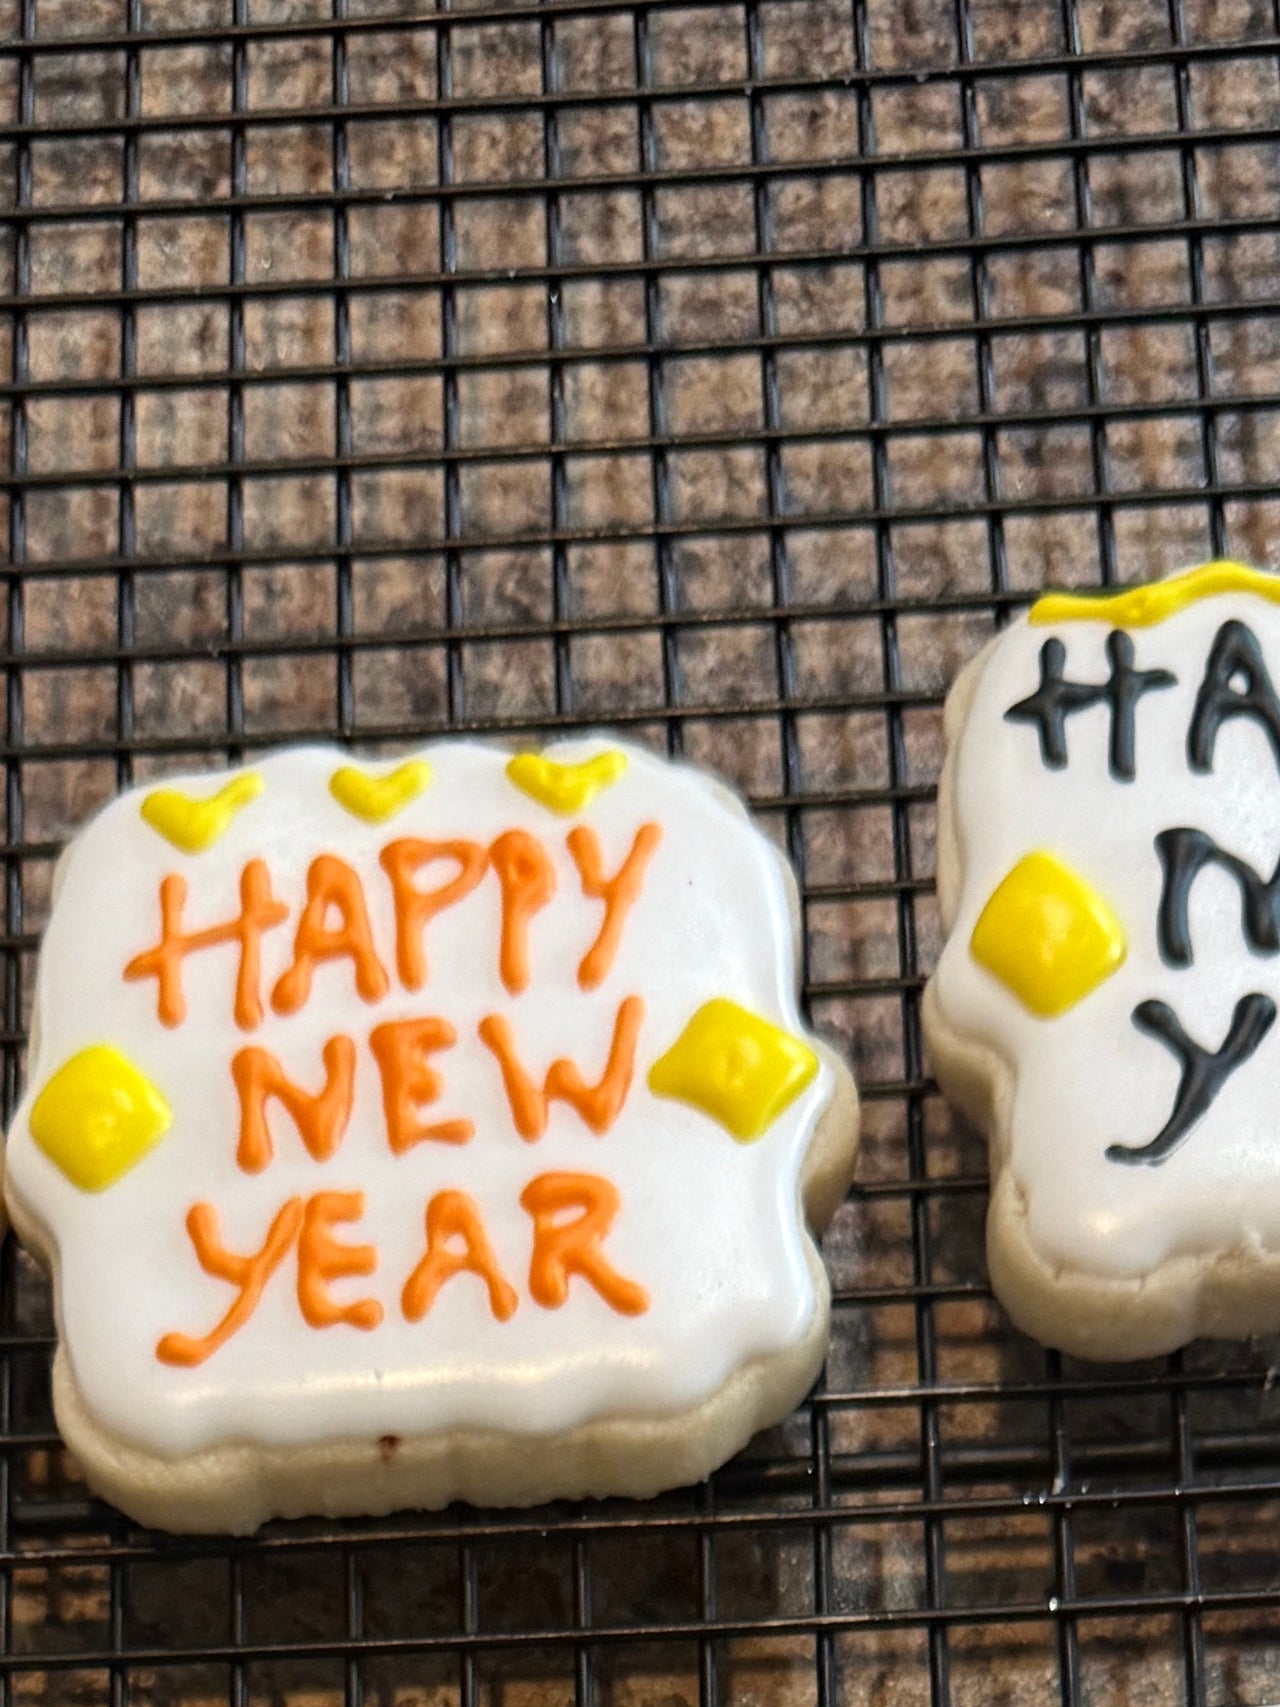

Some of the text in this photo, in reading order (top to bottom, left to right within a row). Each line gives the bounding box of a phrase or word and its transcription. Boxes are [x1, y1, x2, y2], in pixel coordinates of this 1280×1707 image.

[124, 824, 657, 1030] HAPPY
[231, 997, 639, 1173] NEW
[156, 1172, 646, 1366] YEAR
